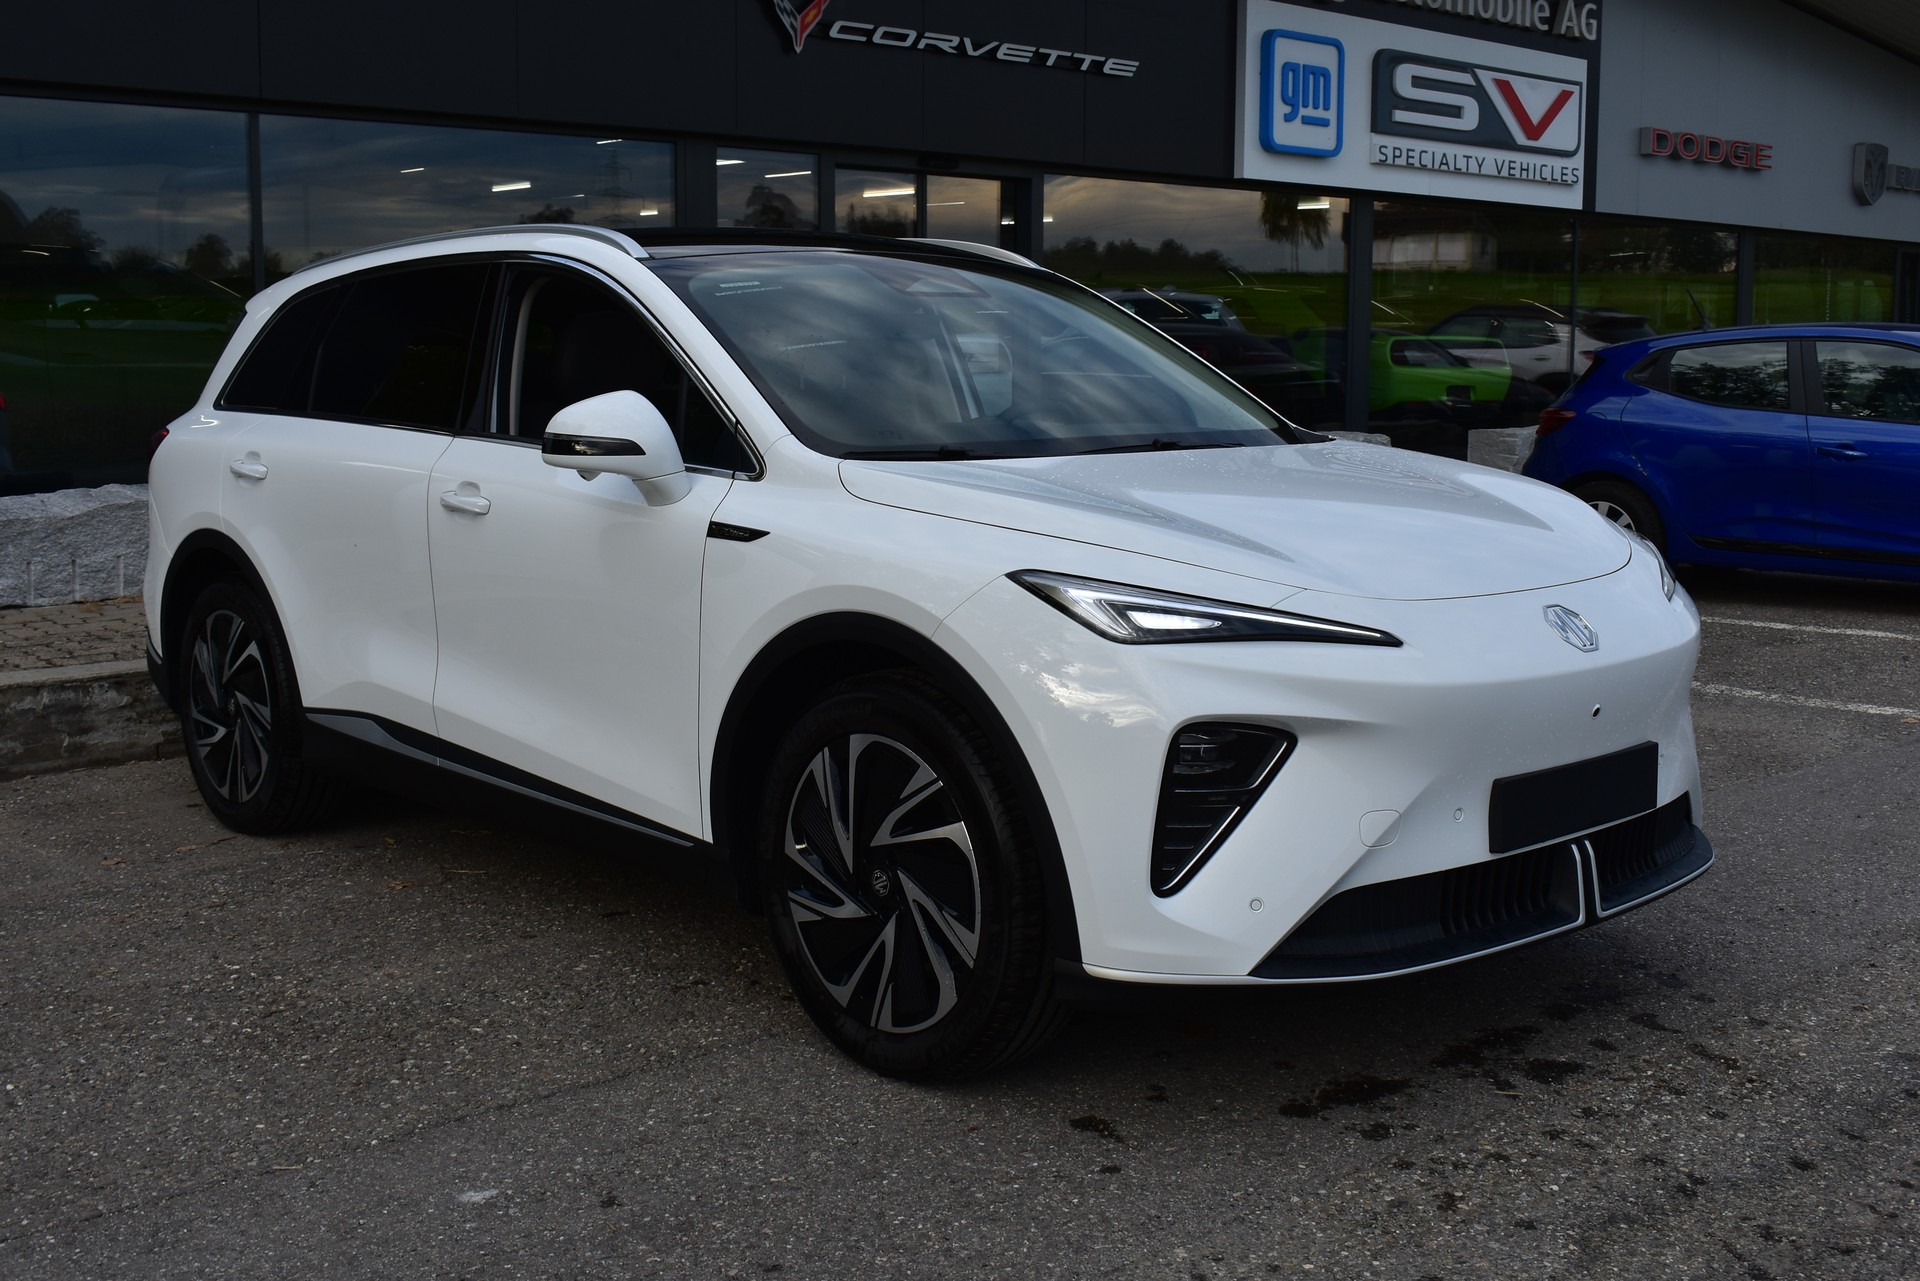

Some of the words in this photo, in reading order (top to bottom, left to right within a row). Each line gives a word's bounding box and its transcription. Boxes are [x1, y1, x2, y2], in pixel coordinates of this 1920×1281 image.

[1560, 0, 1598, 40] AG
[829, 20, 1140, 77] CORVETTE
[1281, 61, 1332, 126] gm
[1391, 63, 1575, 141] SV
[1377, 144, 1486, 175] SPECIALTY
[1494, 157, 1580, 184] VEHICLES
[1650, 127, 1774, 170] DODGE
